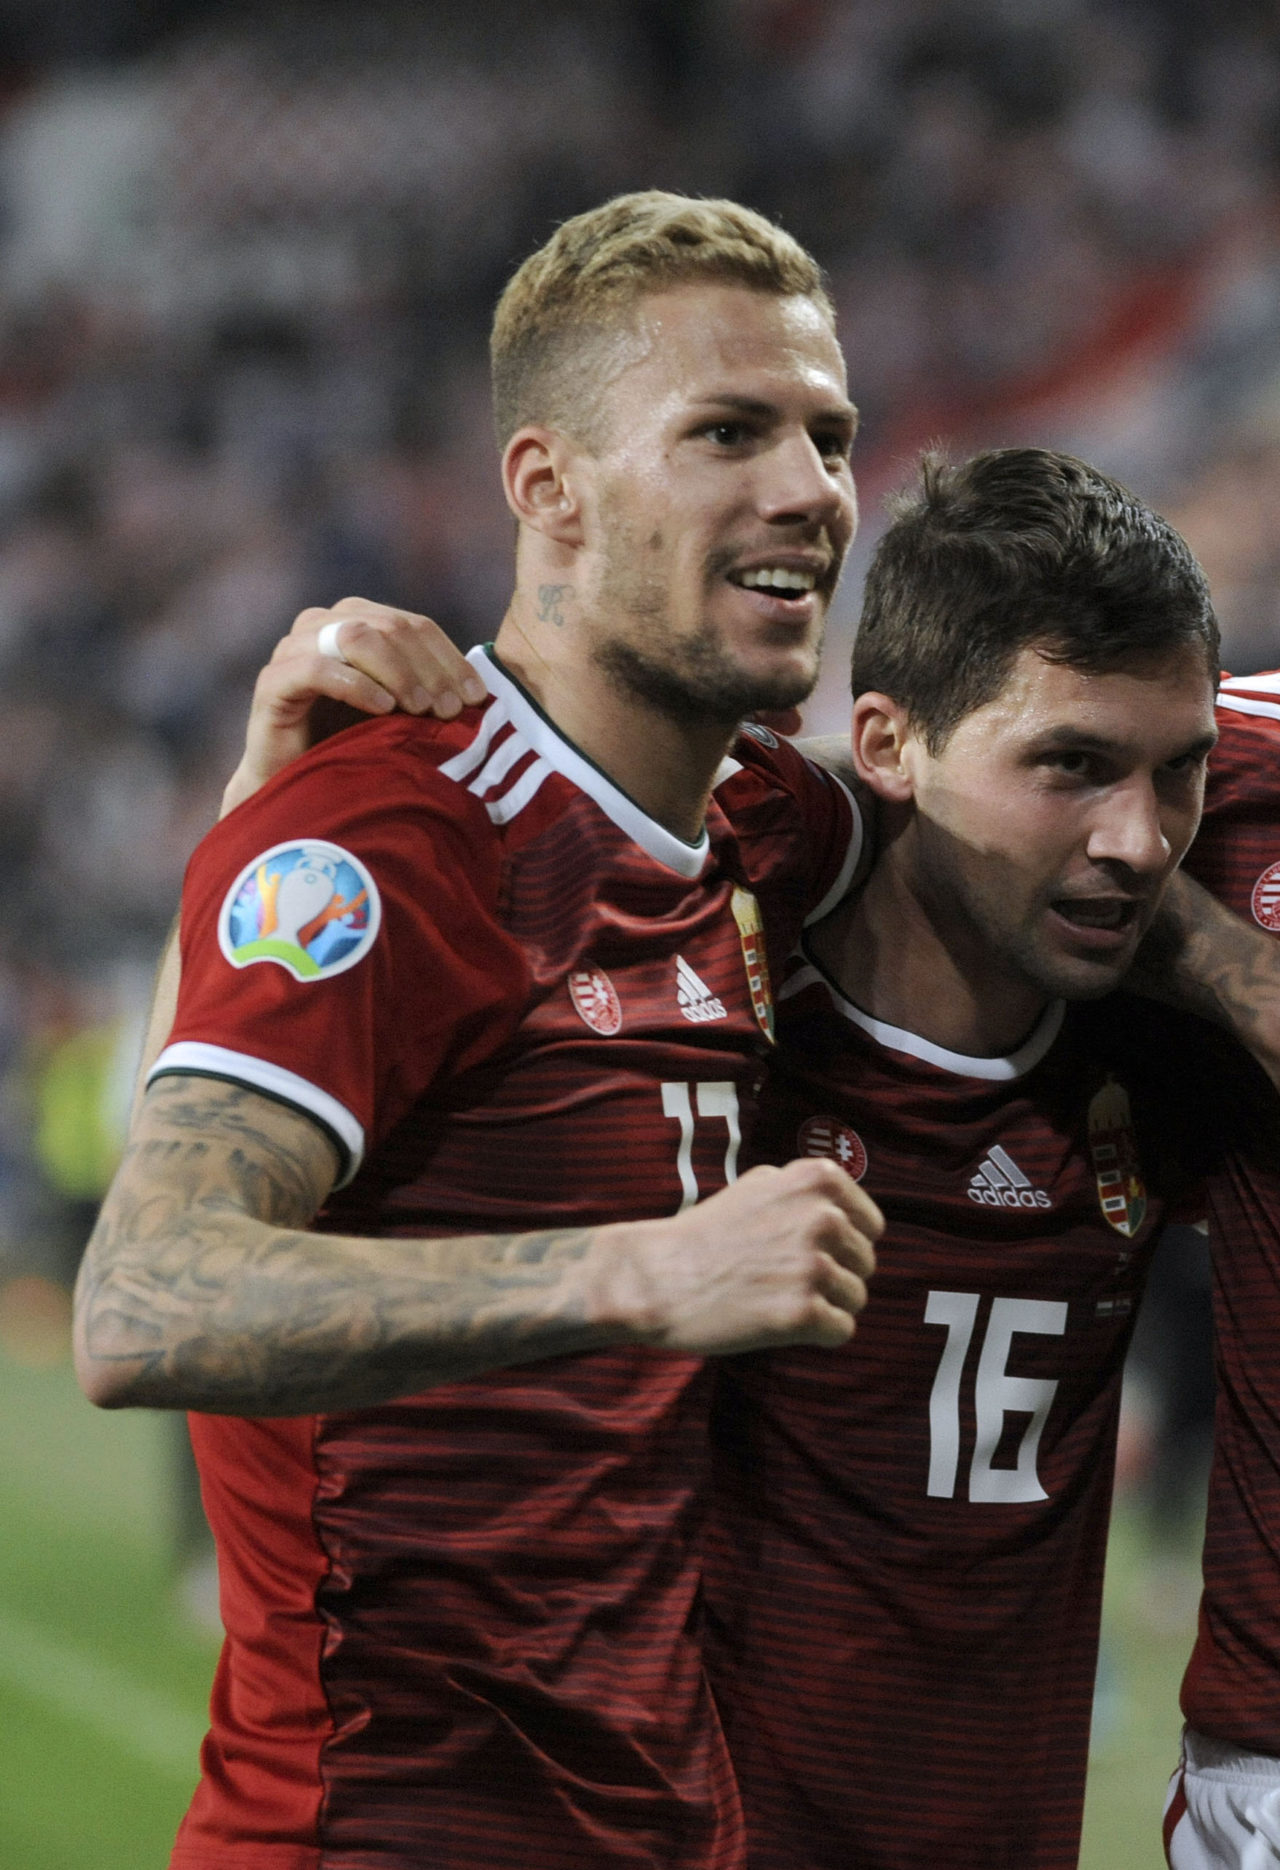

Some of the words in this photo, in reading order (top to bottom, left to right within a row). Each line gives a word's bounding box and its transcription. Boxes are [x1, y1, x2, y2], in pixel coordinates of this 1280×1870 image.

[661, 1082, 742, 1216] 17
[967, 1185, 1052, 1209] adidas
[924, 1290, 1069, 1503] 16
